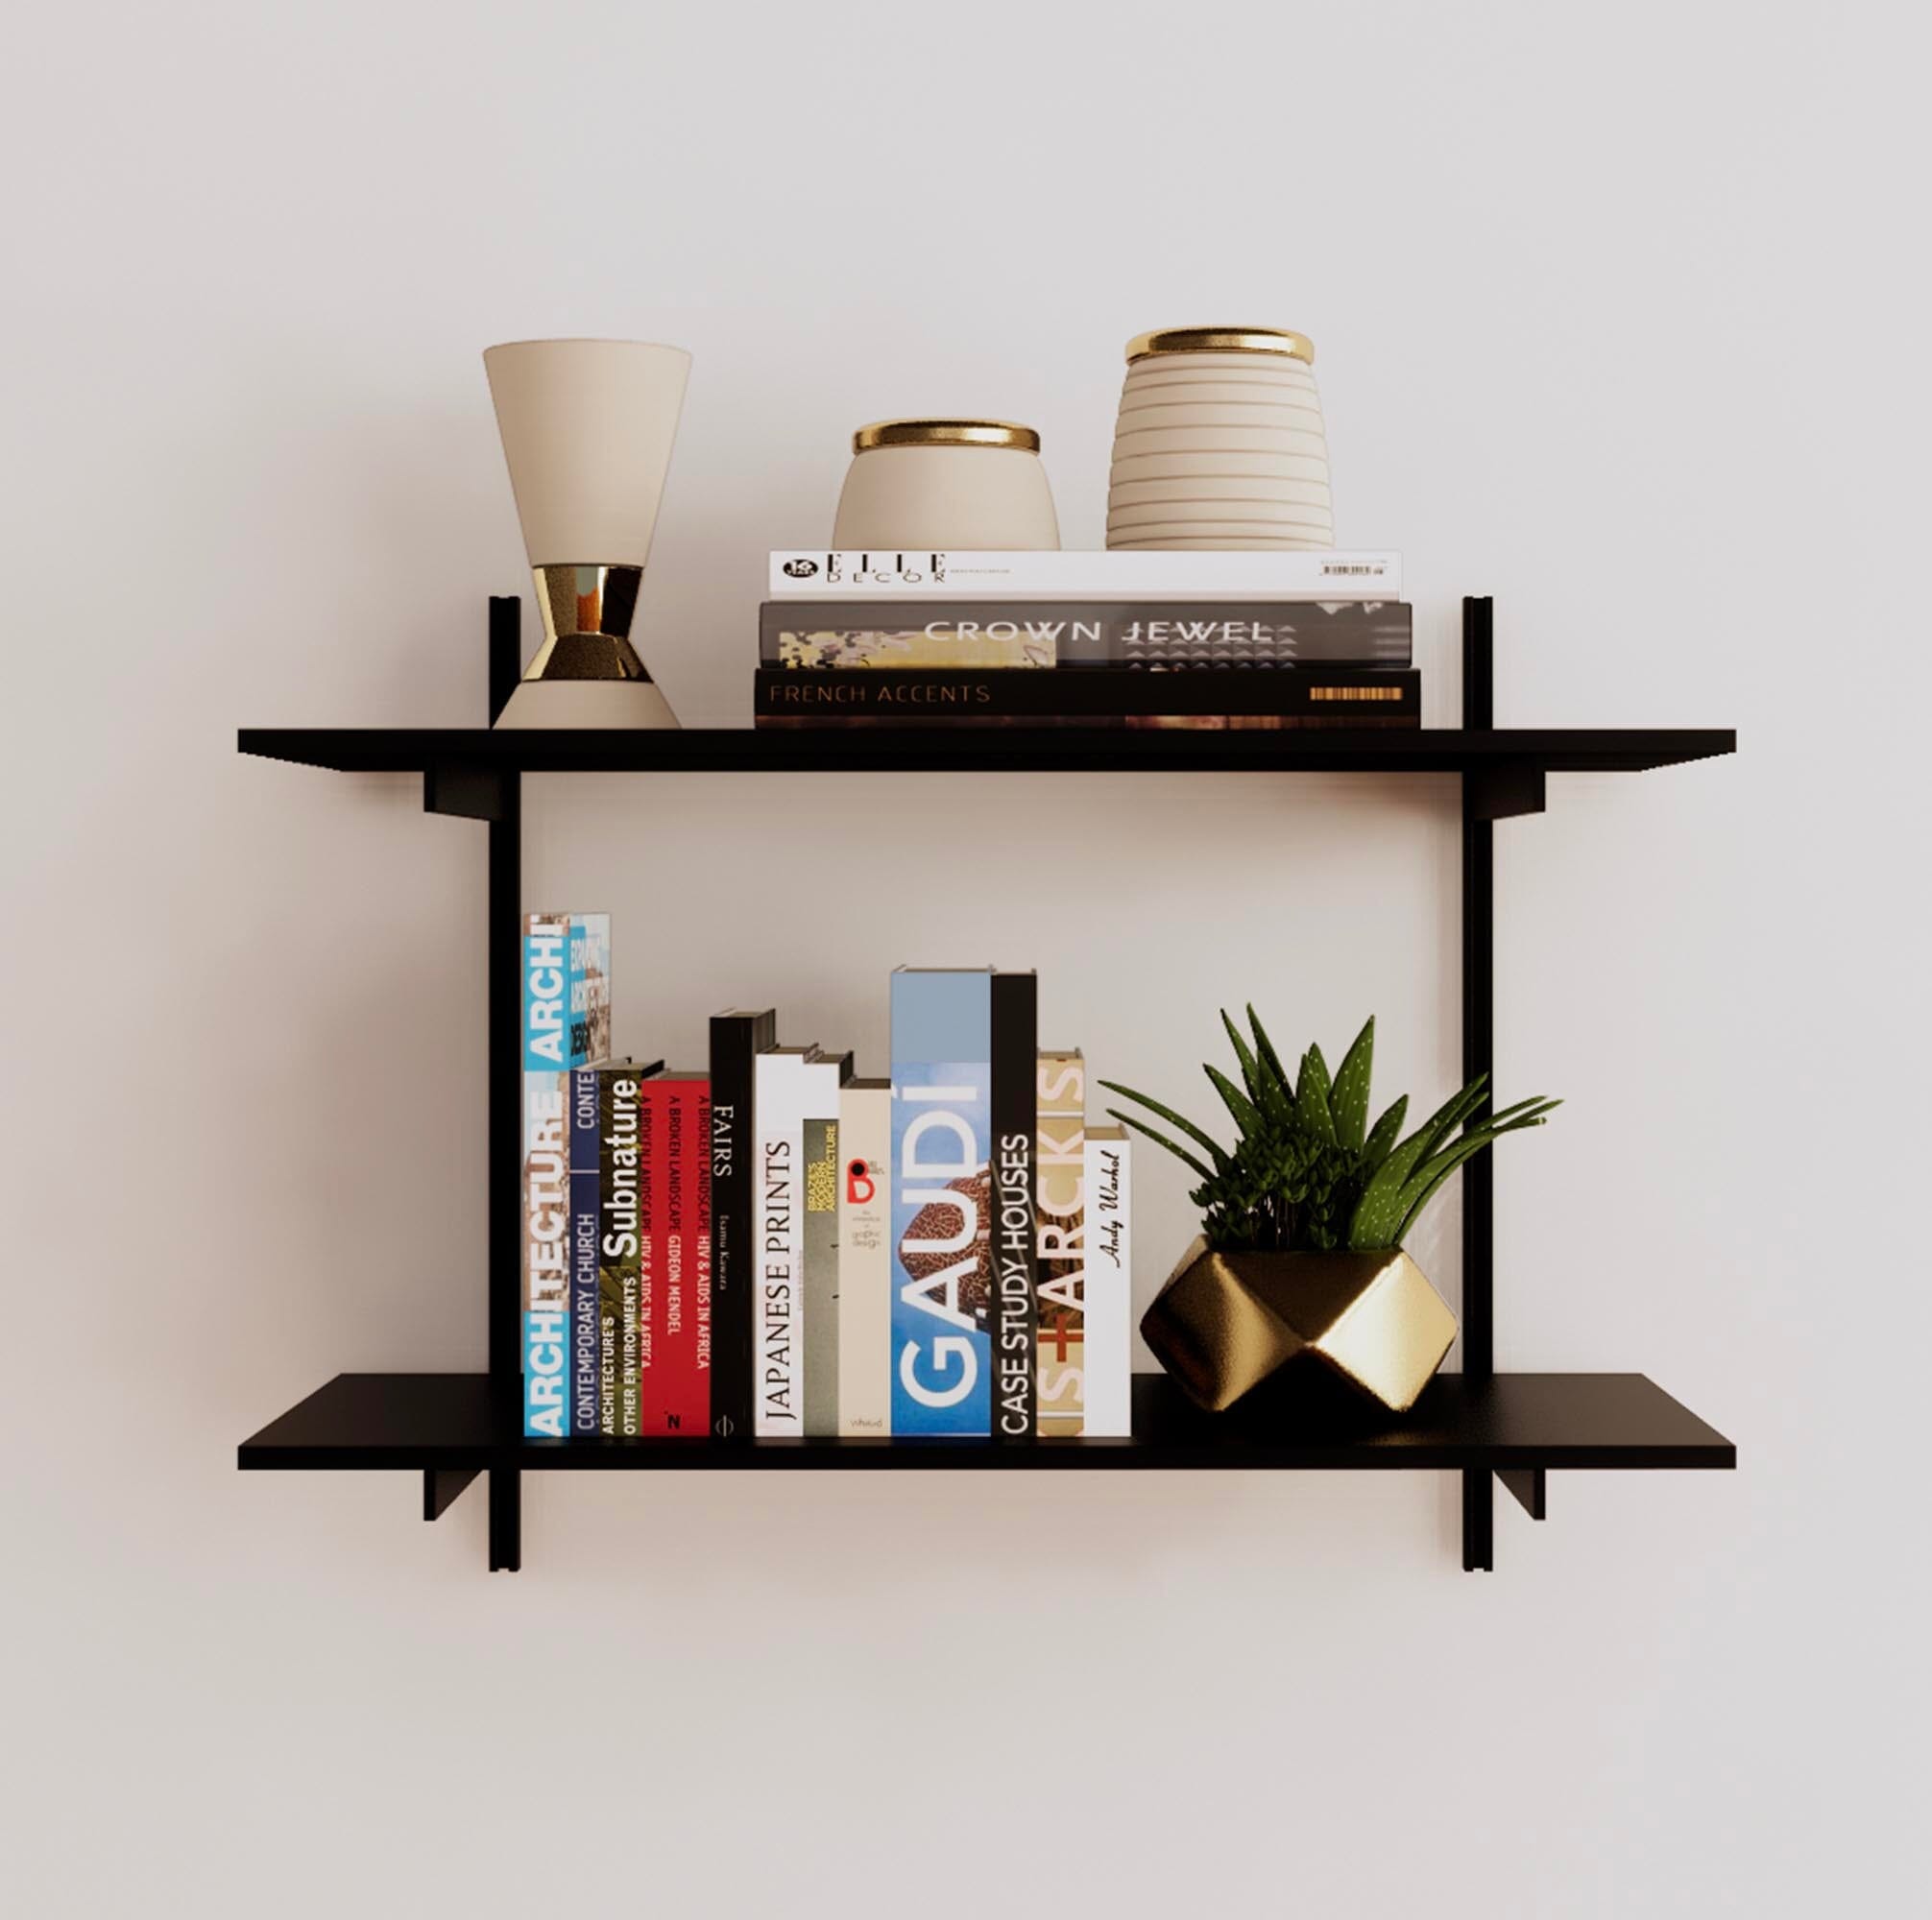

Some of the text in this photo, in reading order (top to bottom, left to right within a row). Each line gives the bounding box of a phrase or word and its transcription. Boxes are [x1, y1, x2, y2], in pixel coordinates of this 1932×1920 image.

[827, 554, 946, 573] ELLE
[827, 572, 946, 584] DECOR
[924, 621, 1273, 641] CROWN JEWEL
[770, 684, 991, 703] FRENCH ACCENTS
[667, 1108, 681, 1157] BROKEN
[697, 1108, 711, 1157] BROKEN
[713, 1105, 734, 1177] FAIRS
[602, 1078, 638, 1259] Subnature
[667, 1161, 681, 1232] LANDSCAPE
[697, 1161, 711, 1232] LANDSCAPE
[826, 1124, 836, 1212] ARCHITECTURE
[1099, 1149, 1124, 1269] Andy Warhol
[529, 1091, 565, 1437] ARCHITECTURE
[667, 1235, 681, 1282] GIDEON
[697, 1235, 711, 1259] HIV
[667, 1285, 681, 1336] MENDEL
[697, 1273, 711, 1304] AIDS
[765, 1140, 797, 1420] JAPANESE PRINTS
[1001, 1133, 1029, 1435] CASE STUDY HOUSES
[576, 1212, 594, 1430] CONTEMPORARY CHURCH
[697, 1306, 711, 1322] IN
[601, 1316, 615, 1435] ARCHITECTURE'S
[622, 1276, 637, 1436] OTHER ENVIRONMENTS
[697, 1324, 711, 1369] AFRICA
